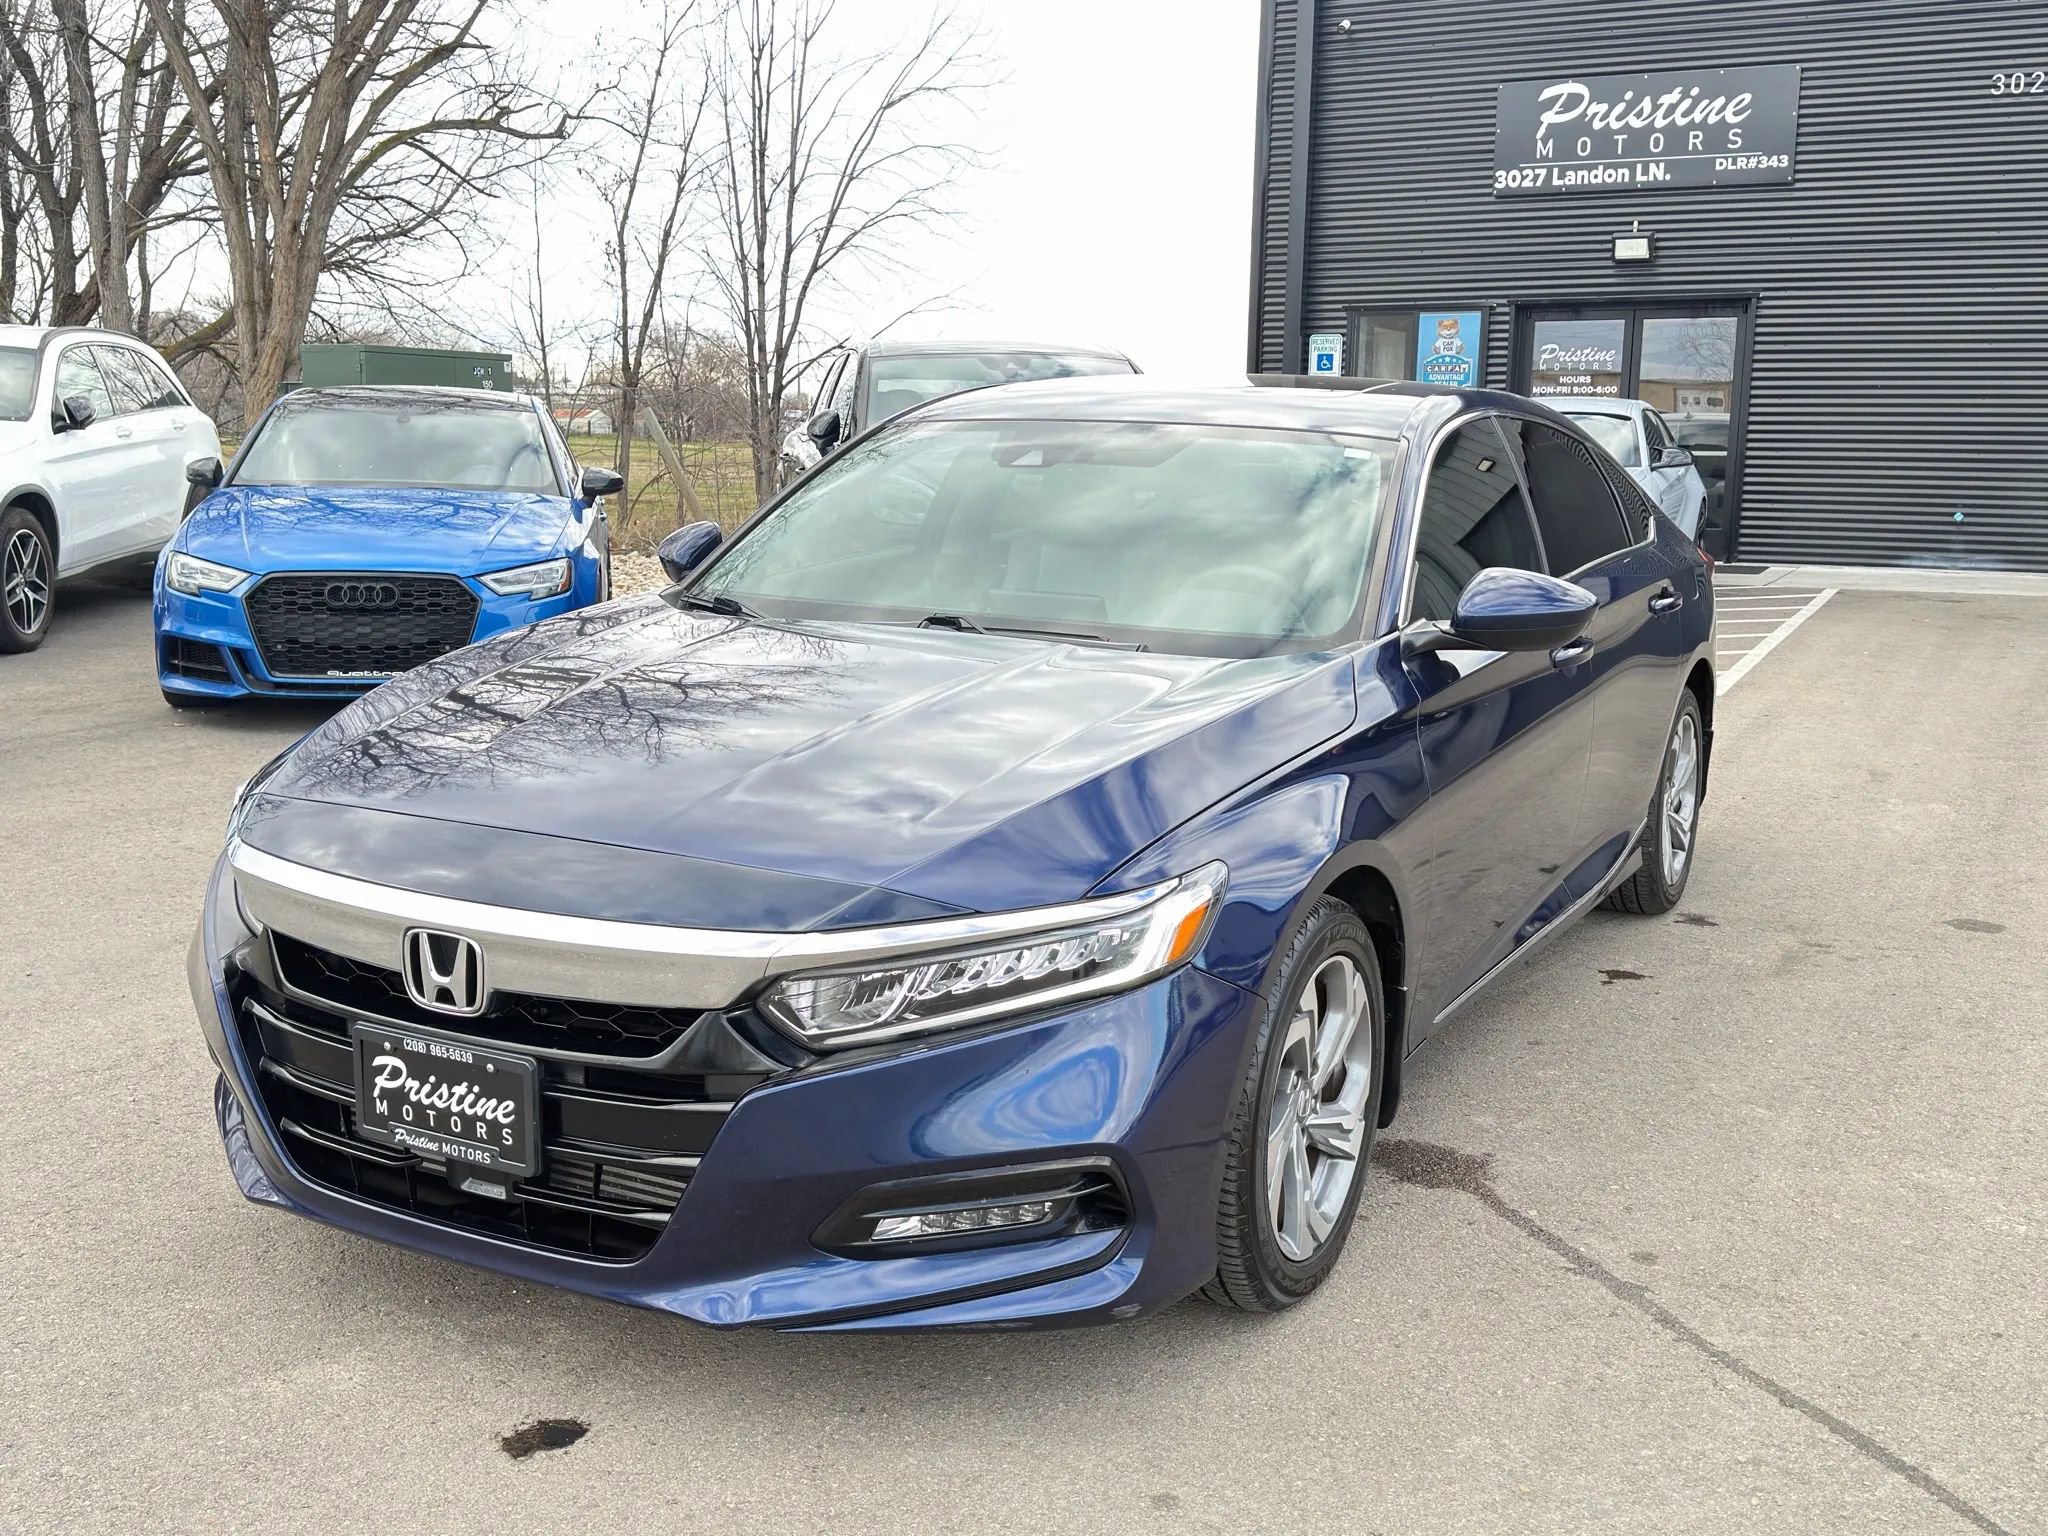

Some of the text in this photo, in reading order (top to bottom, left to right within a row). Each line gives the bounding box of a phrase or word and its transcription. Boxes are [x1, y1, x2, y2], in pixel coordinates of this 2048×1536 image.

[1990, 71, 2045, 95] 302
[1537, 82, 1752, 139] Pristine
[1536, 128, 1743, 159] MOTORS
[1715, 154, 1789, 171] DLR#343
[1494, 162, 1671, 189] 3027 Landon LN.
[1312, 338, 1340, 346] RESERVED
[1539, 343, 1616, 366] Pristine
[1539, 362, 1613, 371] MOTORS
[1425, 364, 1469, 373] CARFAX
[1559, 375, 1592, 384] HOURS
[1532, 386, 1618, 394] MON-FRI 9:00-6:00
[403, 1038, 473, 1063] (208) 965-5639
[372, 1055, 515, 1124] Pristine
[376, 1097, 513, 1146] MOTORS
[394, 1129, 491, 1164] Pristine MOTORS
